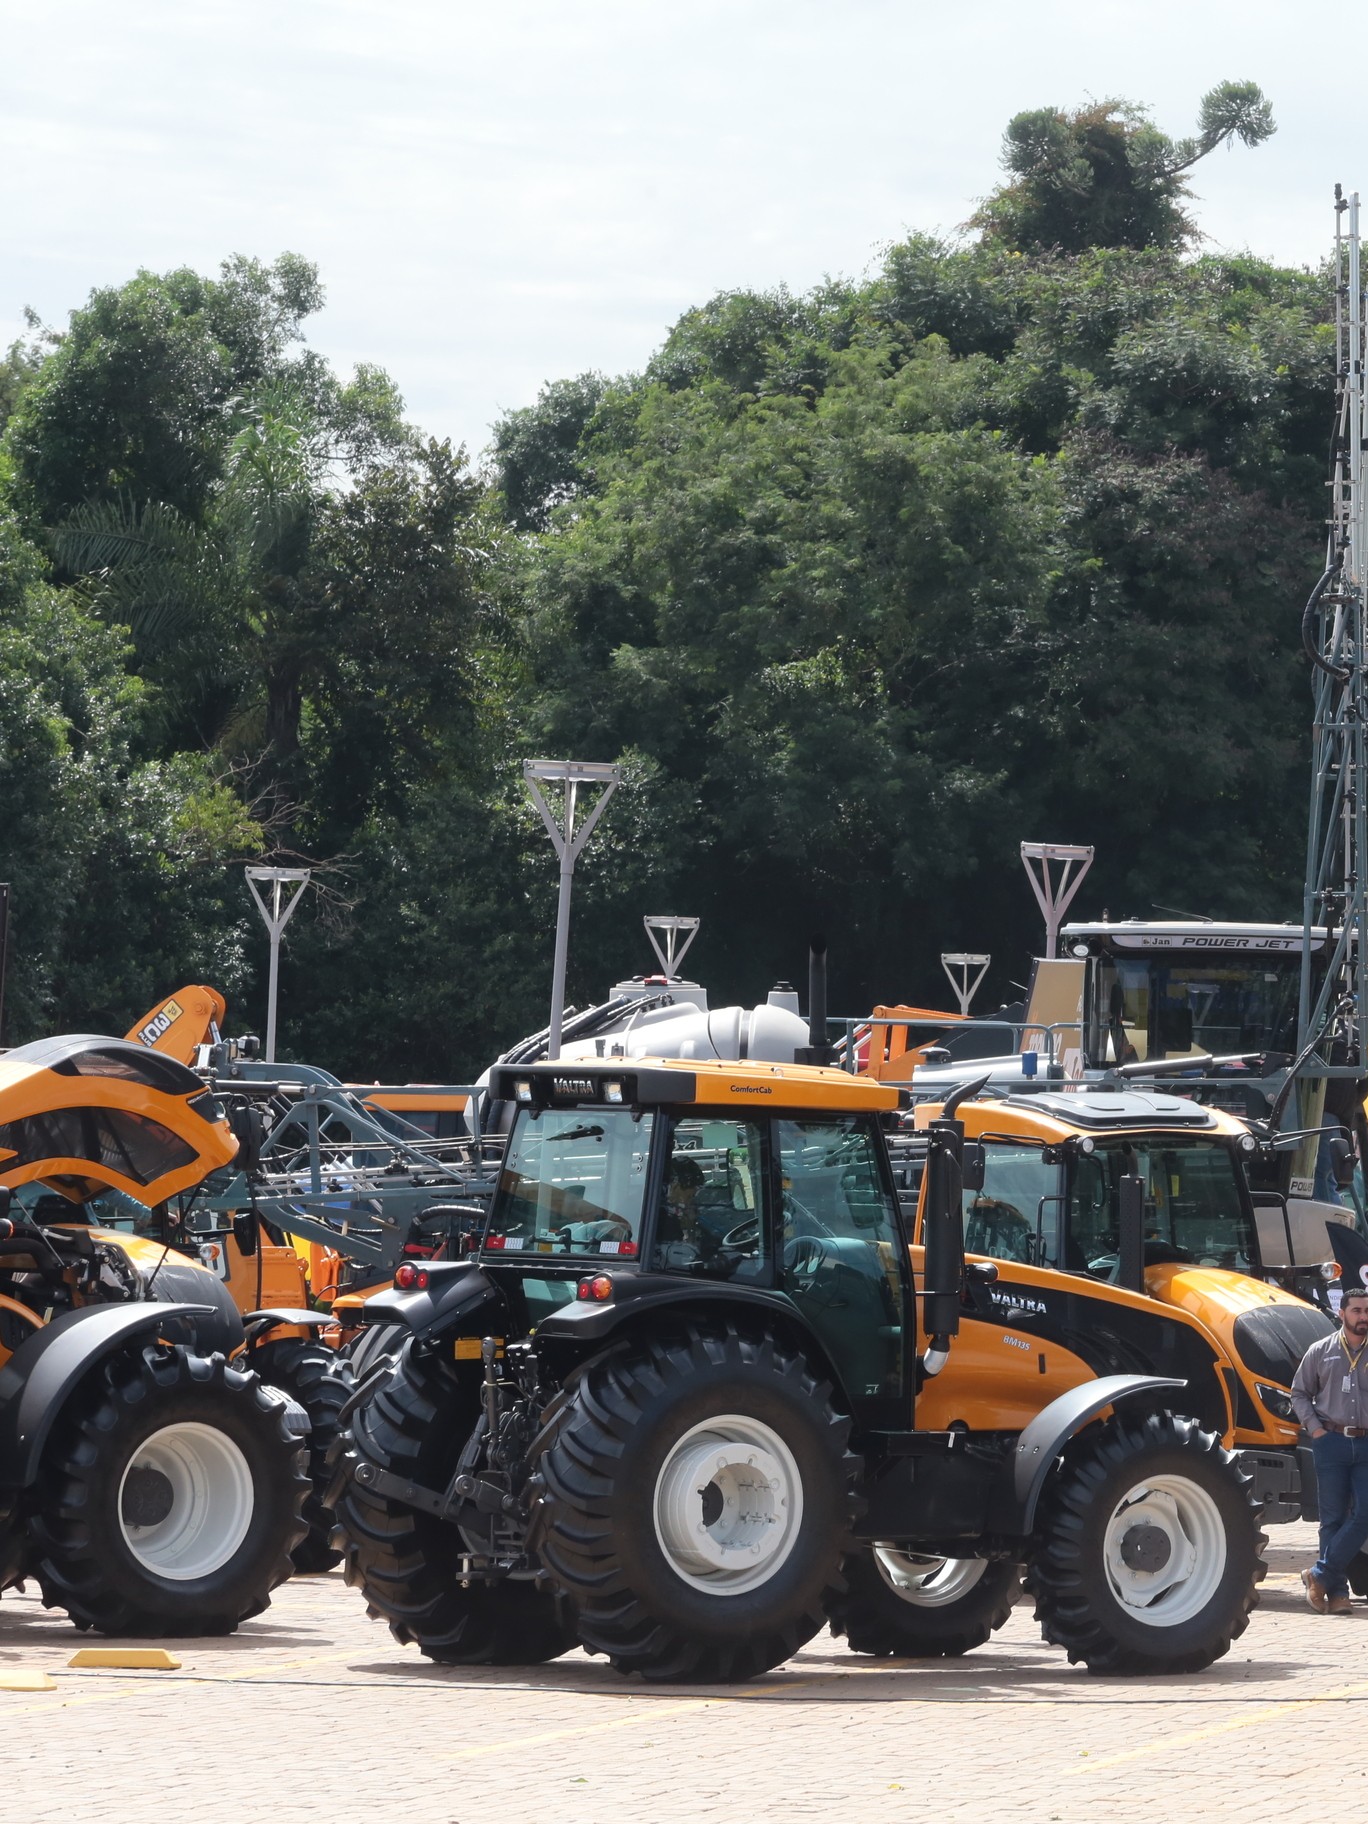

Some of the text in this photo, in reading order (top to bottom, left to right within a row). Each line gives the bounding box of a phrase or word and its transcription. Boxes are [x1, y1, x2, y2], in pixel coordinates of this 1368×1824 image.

[1152, 937, 1171, 946] Jan
[1182, 937, 1295, 949] POWER JET
[138, 1031, 153, 1047] PLUS
[553, 1078, 594, 1094] VALTRA
[730, 1085, 772, 1094] ComfortCab
[989, 1287, 1047, 1314] VALTRA
[1003, 1335, 1031, 1351] BM135
